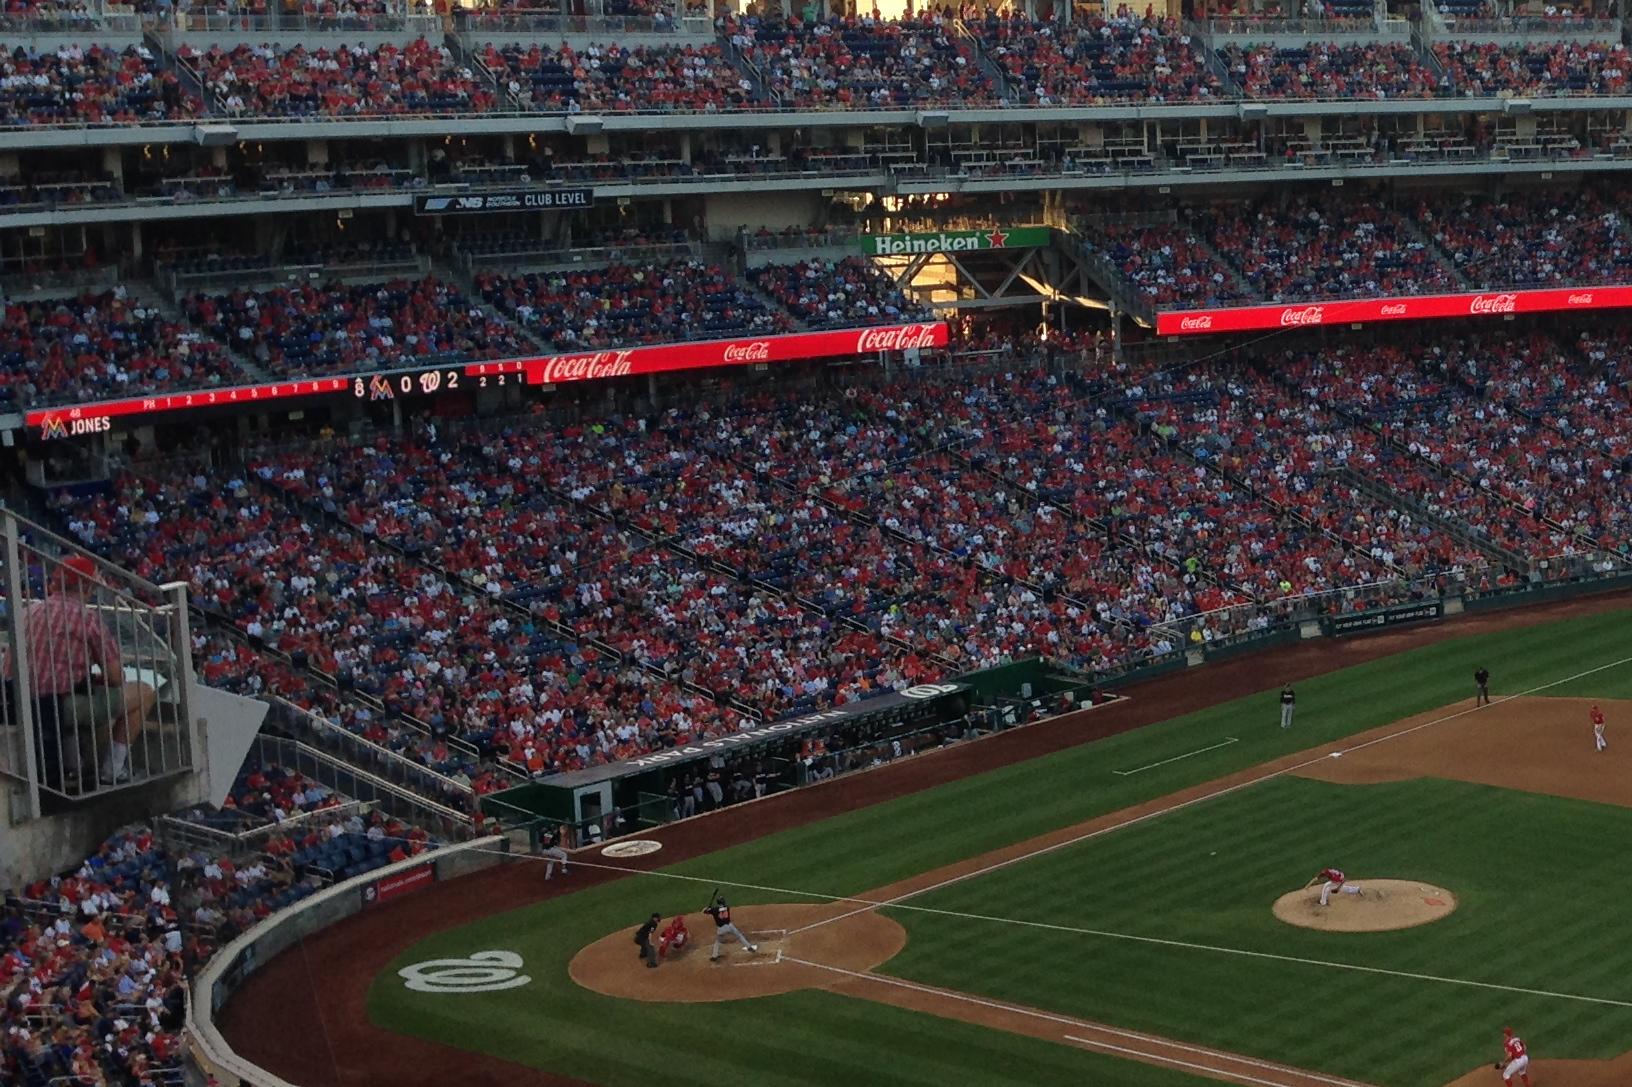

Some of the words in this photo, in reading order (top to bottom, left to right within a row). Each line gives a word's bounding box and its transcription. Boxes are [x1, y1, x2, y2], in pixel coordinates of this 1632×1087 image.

[525, 194, 552, 206] CLUB
[555, 193, 586, 205] LEVEL
[875, 234, 979, 254] Heineken
[1470, 294, 1518, 314] Coca-Cola
[1281, 306, 1325, 326] Coca-Cola
[858, 324, 938, 353] Coca-Cola
[724, 341, 771, 362] Coca-Cola
[543, 350, 633, 383] Coca-Cola
[355, 382, 365, 397] 8
[447, 371, 458, 388] 2
[480, 376, 487, 387] 2
[498, 374, 505, 385] 2
[518, 373, 522, 384] 1
[209, 393, 215, 402] 3
[230, 391, 237, 400] 4
[251, 388, 257, 398] 5
[271, 386, 278, 396] 6
[292, 384, 298, 393] 7
[71, 416, 111, 435] JONES
[626, 746, 703, 767] PARK
